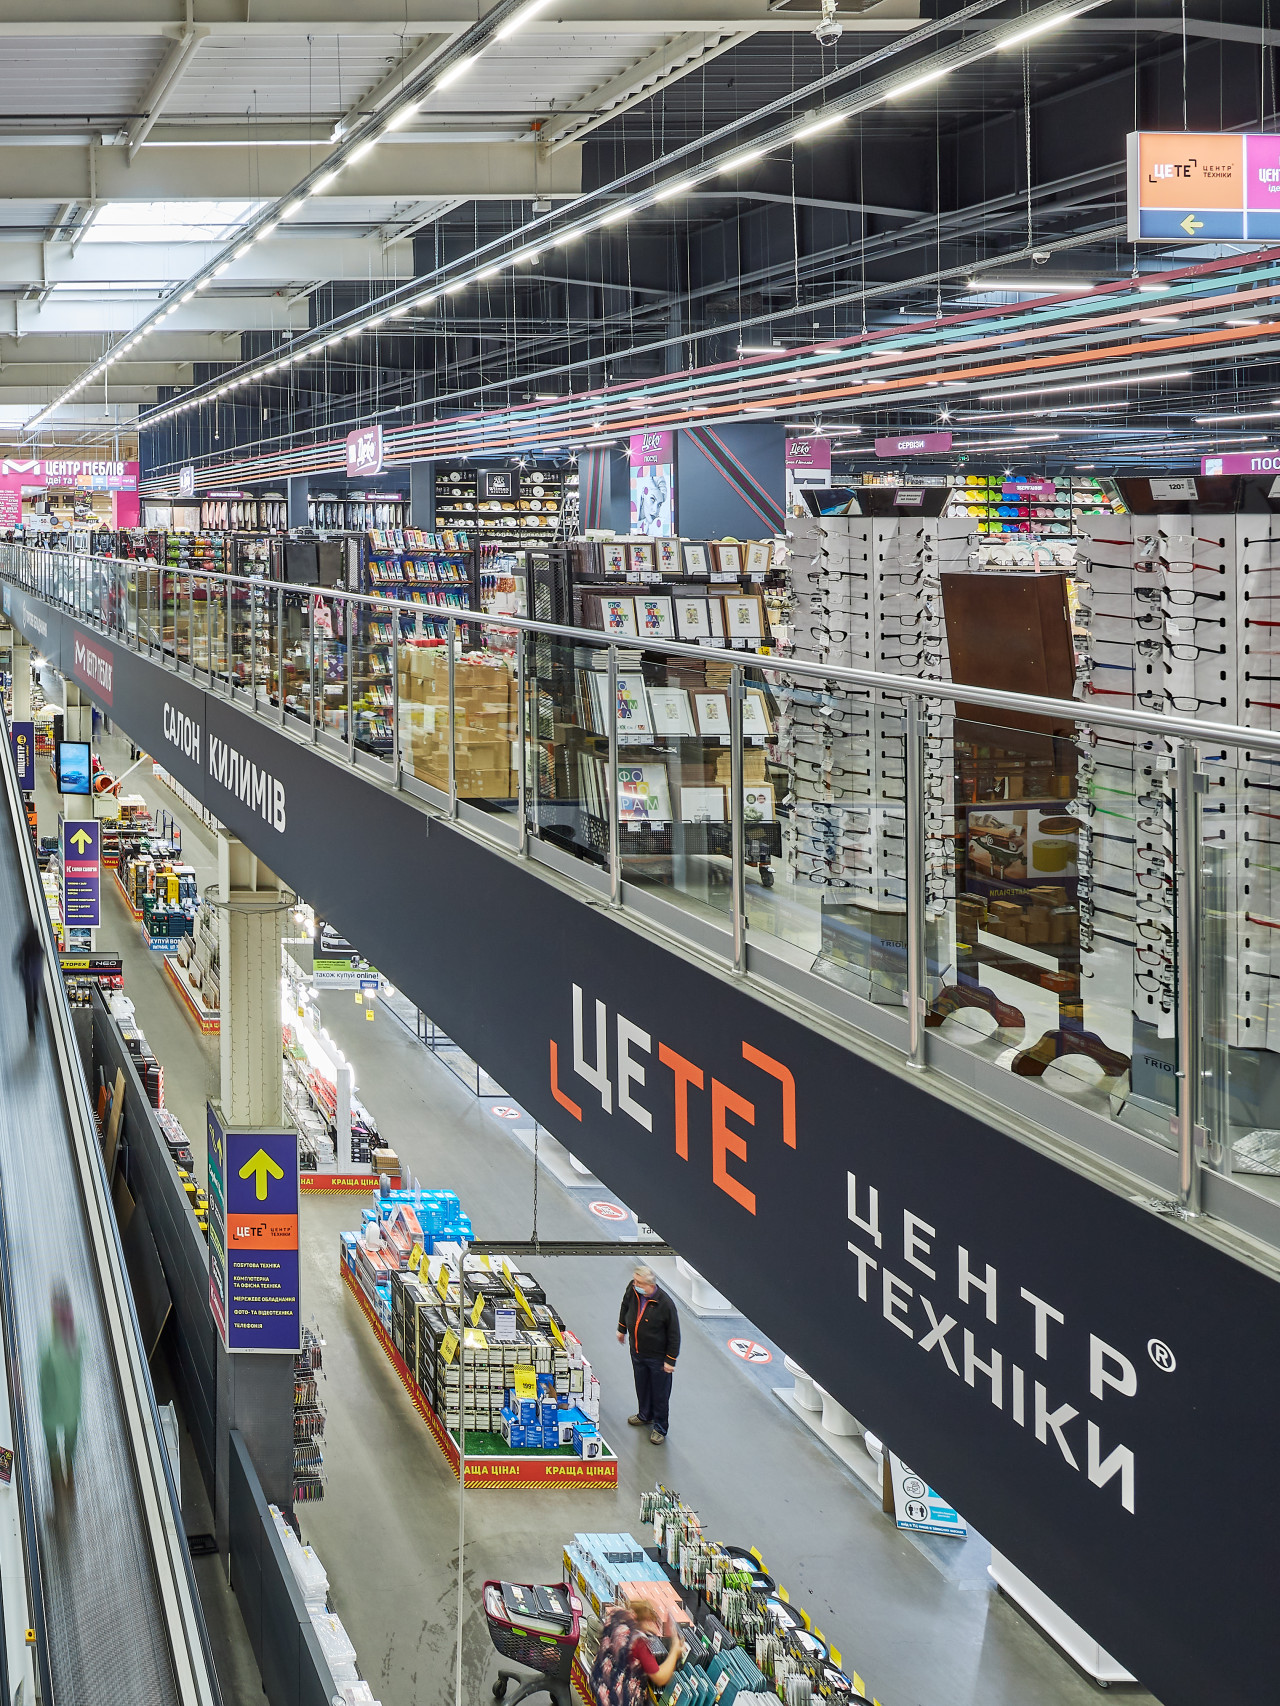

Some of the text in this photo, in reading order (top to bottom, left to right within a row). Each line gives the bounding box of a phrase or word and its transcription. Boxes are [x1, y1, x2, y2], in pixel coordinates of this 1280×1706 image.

[1154, 164, 1191, 179] ЦЕТЕ
[898, 441, 924, 450] СЕРВІЗИ
[45, 461, 124, 476] ЦЕНТР МЕБЛІВ
[63, 477, 73, 485] та
[86, 649, 113, 693] ЦЕНТР МЕБЛІВ
[163, 702, 287, 834] САЛОН КИЛИМІВ
[336, 971, 356, 979] купуй
[573, 982, 756, 1216] ЦЕТЕ
[331, 1178, 360, 1186] КРАЩА
[236, 1226, 263, 1238] ЦЕТЕ
[847, 1170, 1138, 1401] ЦЕНТР
[847, 1241, 1136, 1515] ТЕХНІКИ
[464, 1466, 520, 1476] АЩА ЦІНА!
[545, 1466, 615, 1476] КРАЩА ЦІНА!
